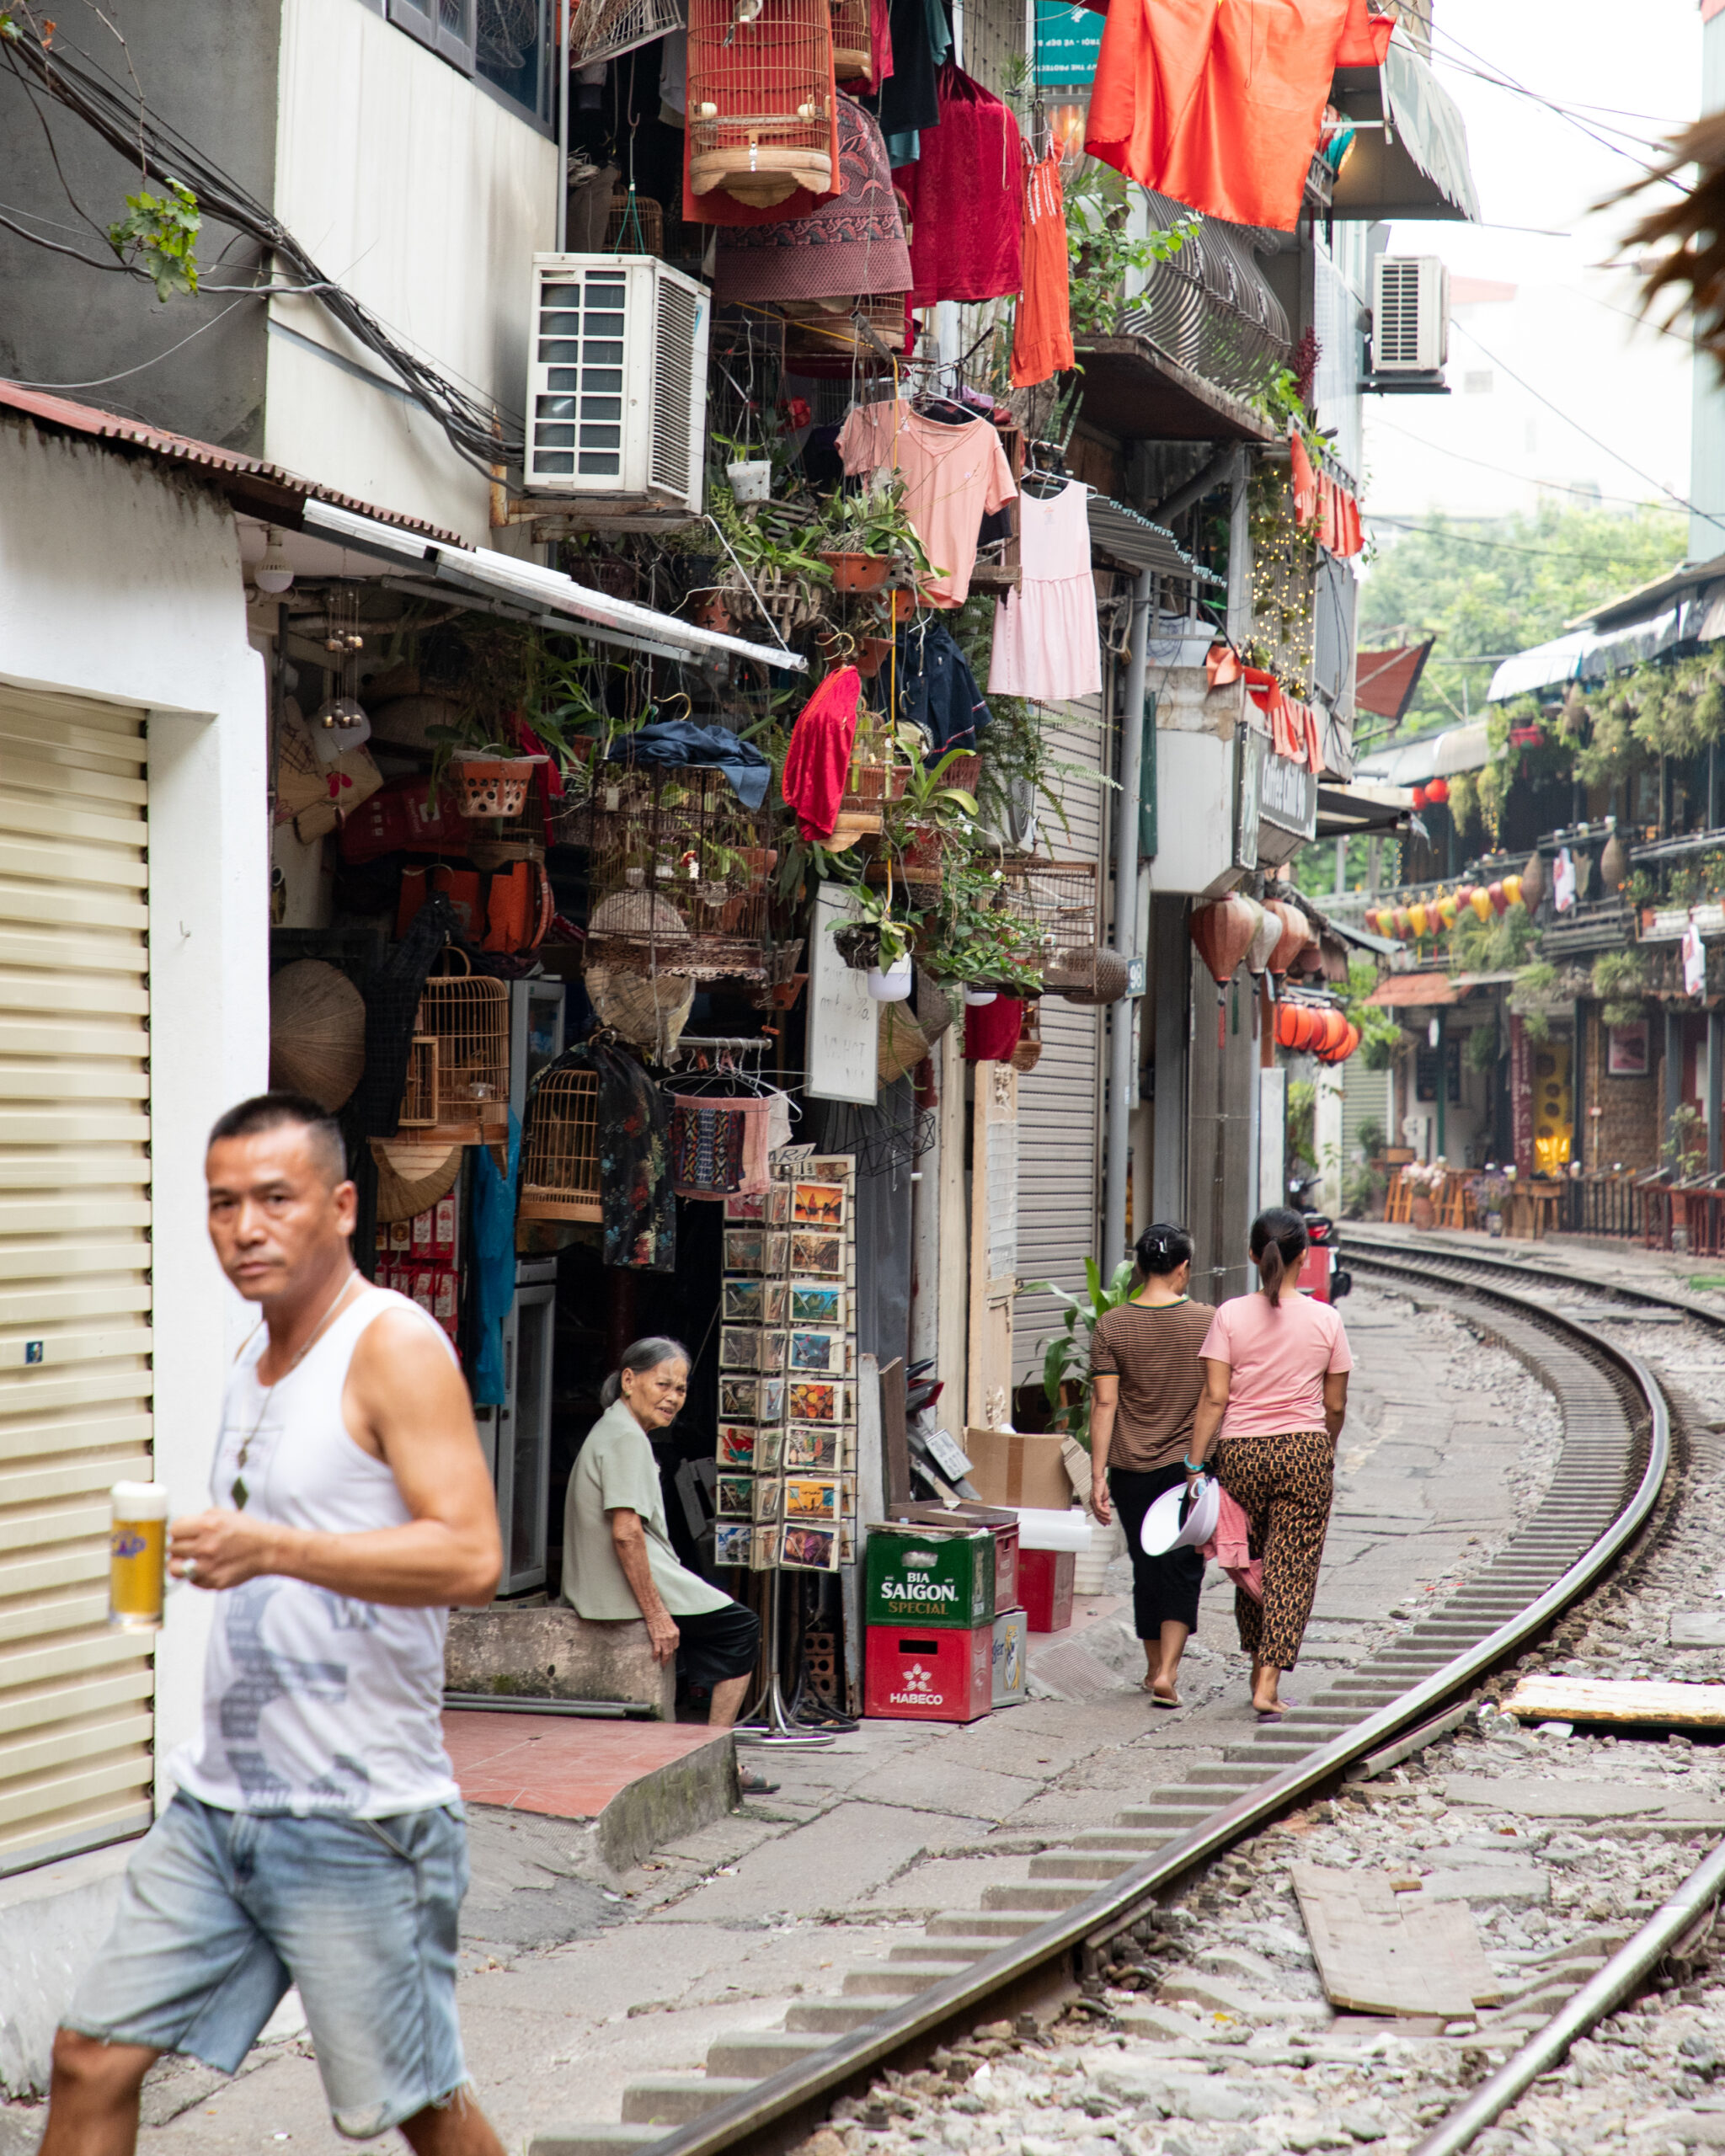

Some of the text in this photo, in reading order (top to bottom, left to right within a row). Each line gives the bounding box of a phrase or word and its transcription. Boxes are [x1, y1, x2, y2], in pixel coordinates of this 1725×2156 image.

[1130, 963, 1142, 990] 98
[768, 1147, 811, 1163] ARd
[906, 1572, 931, 1583] BIA
[881, 1582, 956, 1602] SAIGON
[888, 1601, 949, 1615] SPECIAL
[889, 1693, 943, 1705] HABECO
